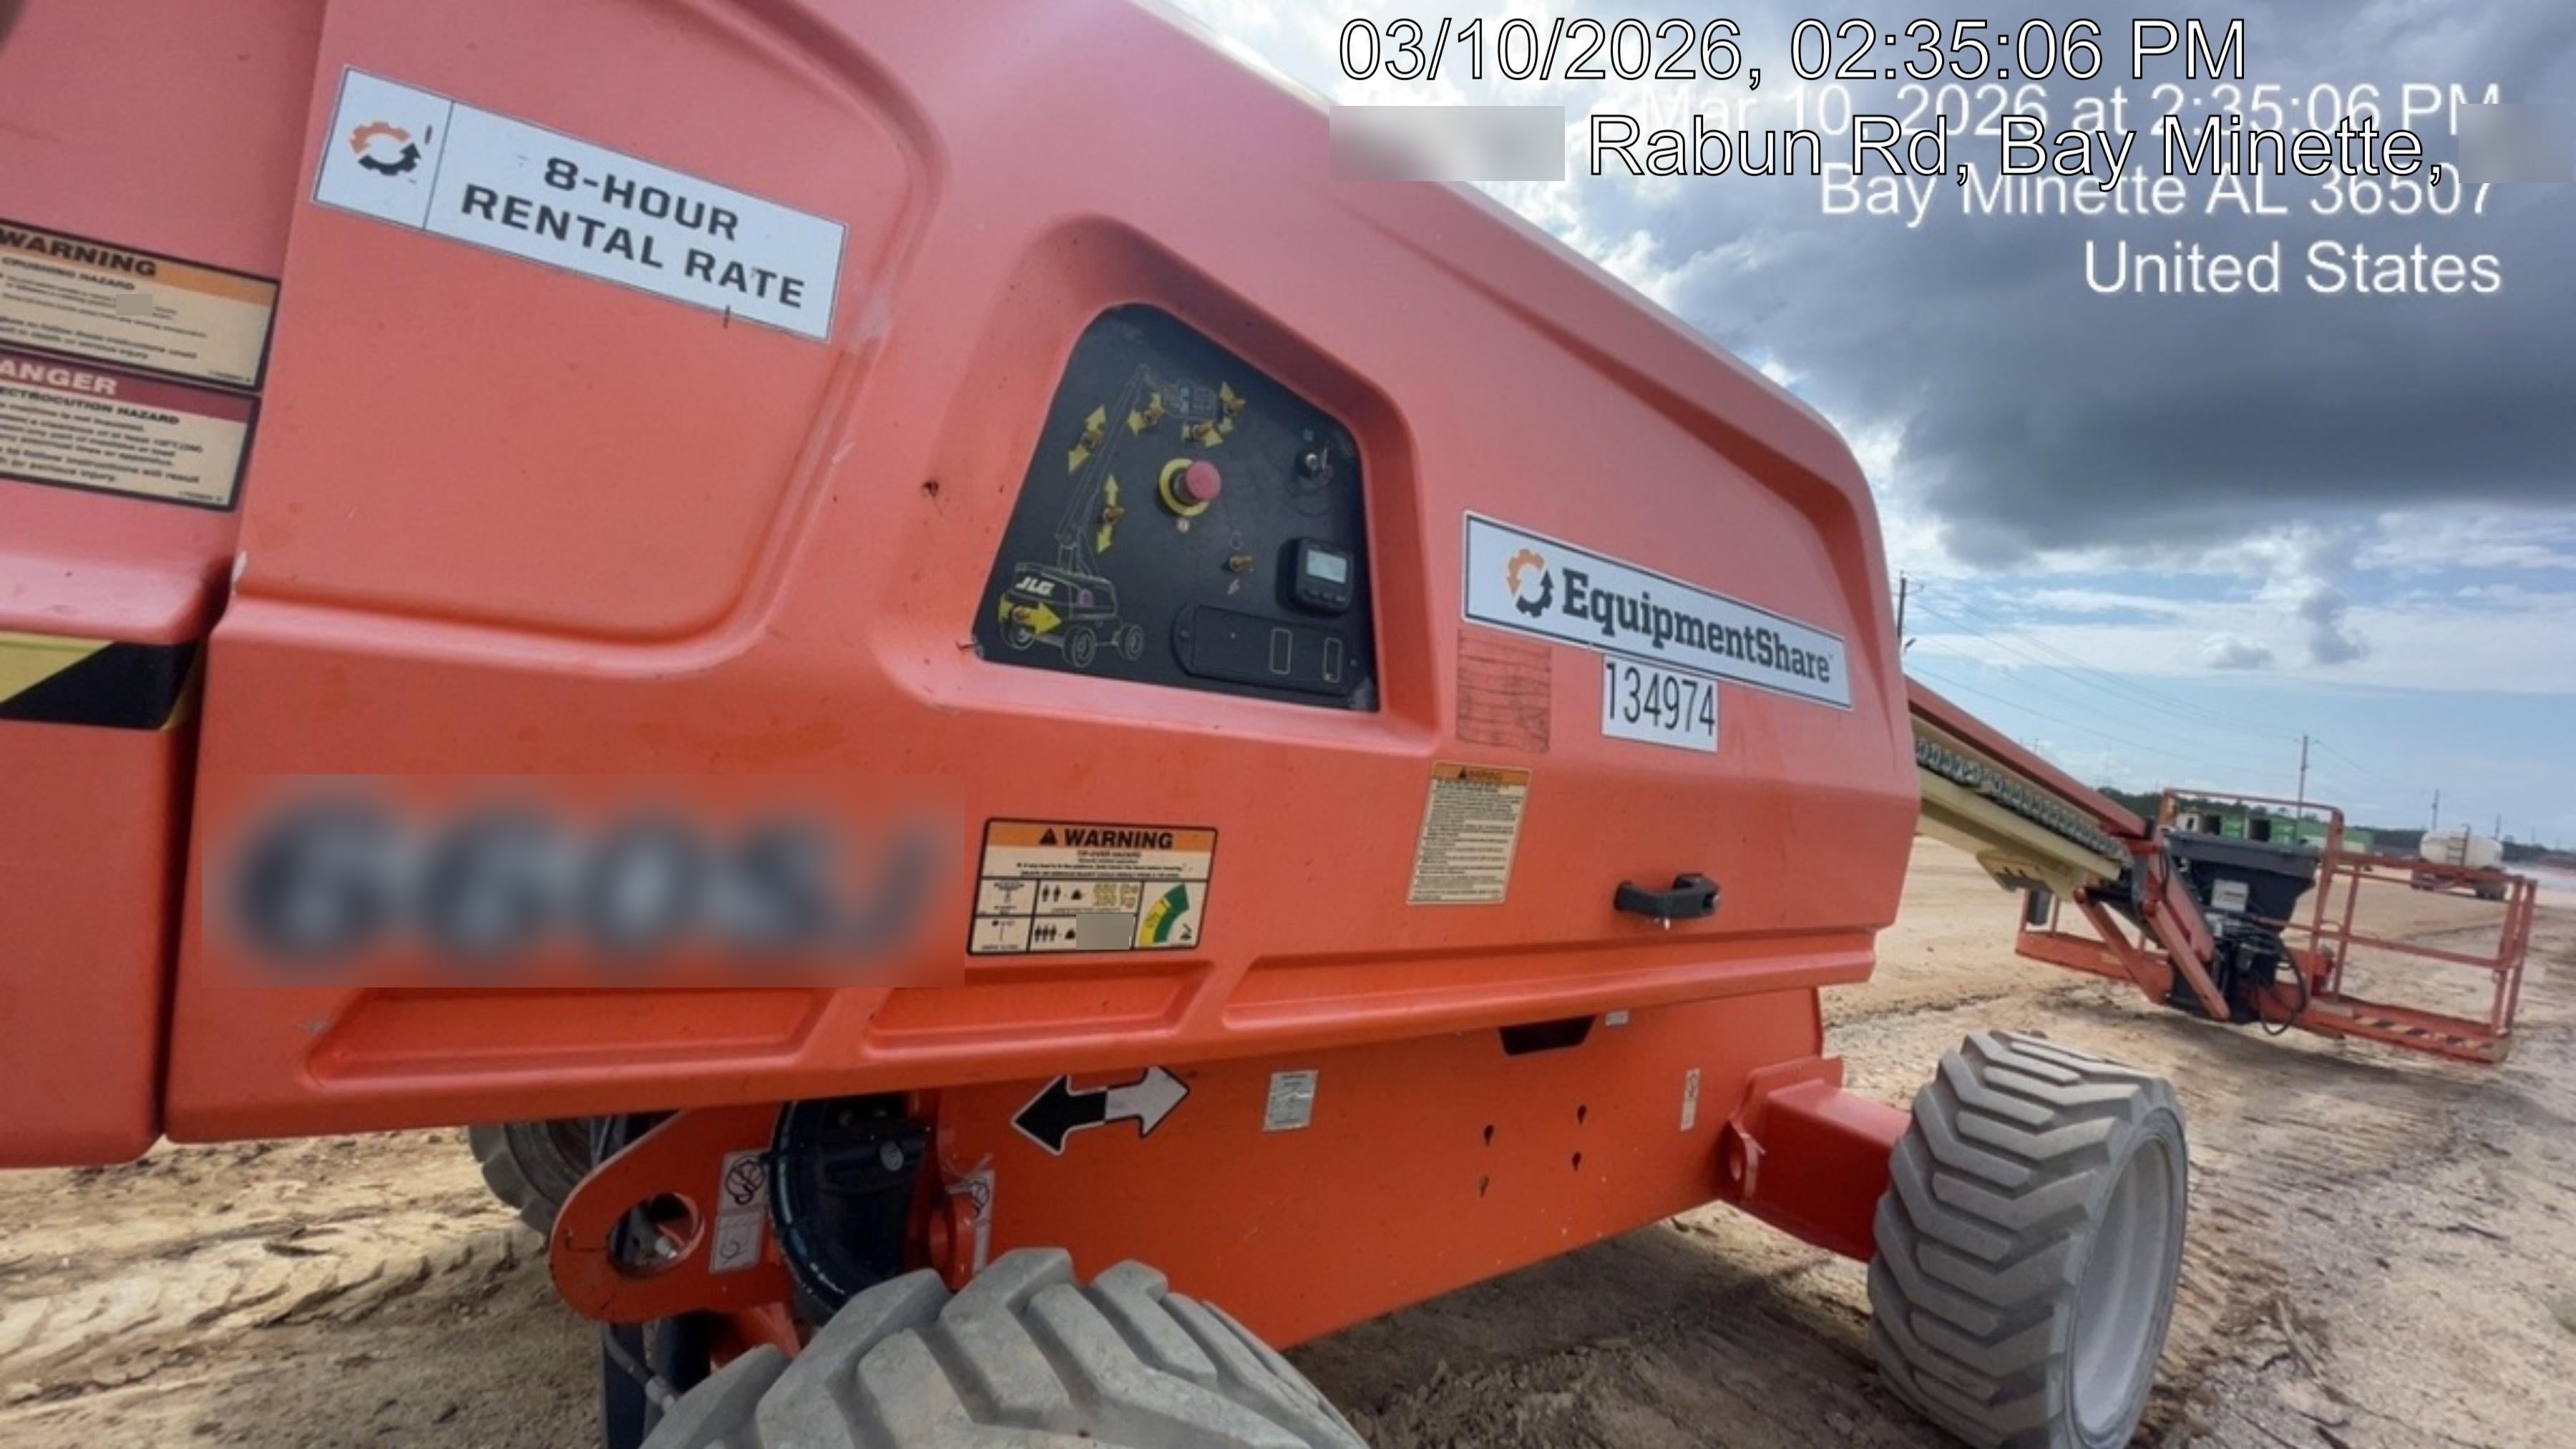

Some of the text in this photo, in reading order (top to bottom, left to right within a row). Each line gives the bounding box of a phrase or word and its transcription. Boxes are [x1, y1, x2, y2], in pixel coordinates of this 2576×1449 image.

[544, 155, 738, 240] 8-HOUR
[0, 228, 156, 278] WARNING
[460, 183, 805, 308] RENTAL RATE
[1561, 567, 1831, 685] EquipmentShare
[1604, 661, 1717, 737] 134974
[1064, 828, 1173, 849] WARNING
